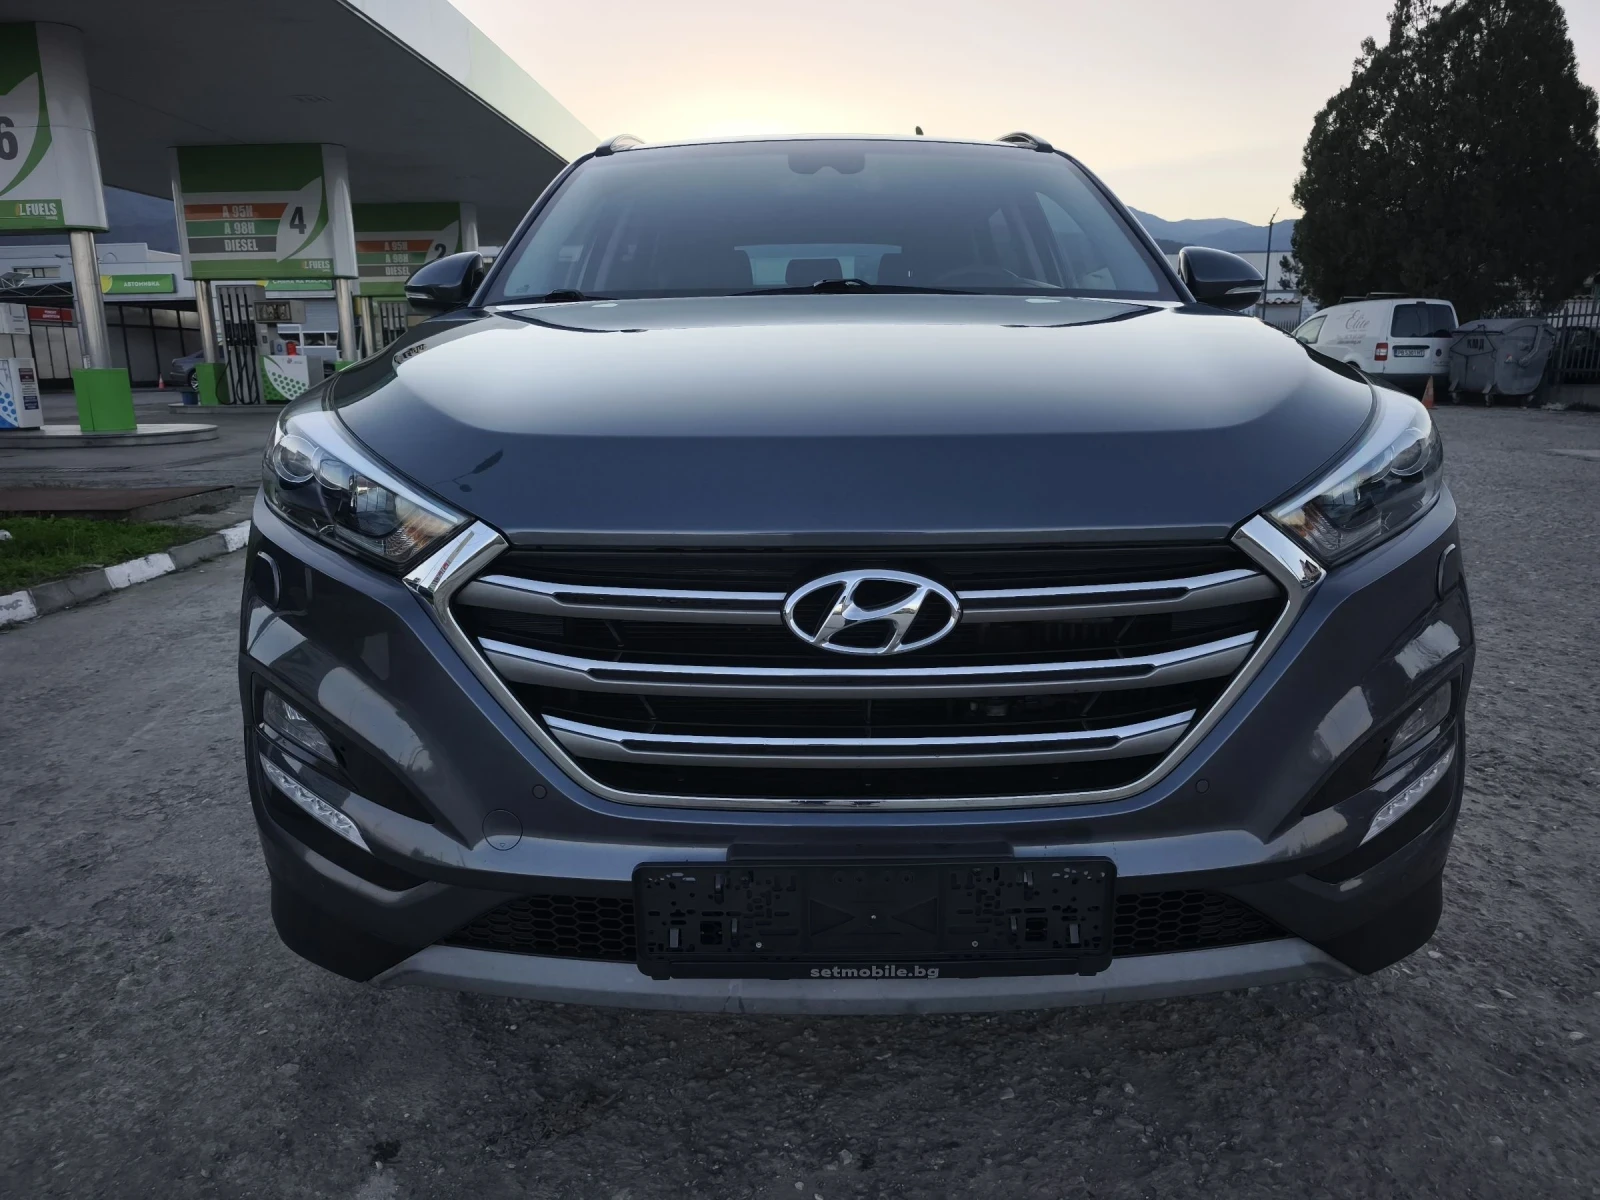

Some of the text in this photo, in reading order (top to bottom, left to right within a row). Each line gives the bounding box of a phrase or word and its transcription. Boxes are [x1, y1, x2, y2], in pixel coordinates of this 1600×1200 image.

[0, 116, 18, 160] 6
[222, 205, 230, 218] A
[289, 206, 307, 235] 4
[224, 222, 231, 234] A
[224, 239, 259, 252] DIESEL
[434, 243, 447, 260] 2
[385, 266, 411, 276] DIESEL
[810, 964, 940, 979] setmobile.bg
